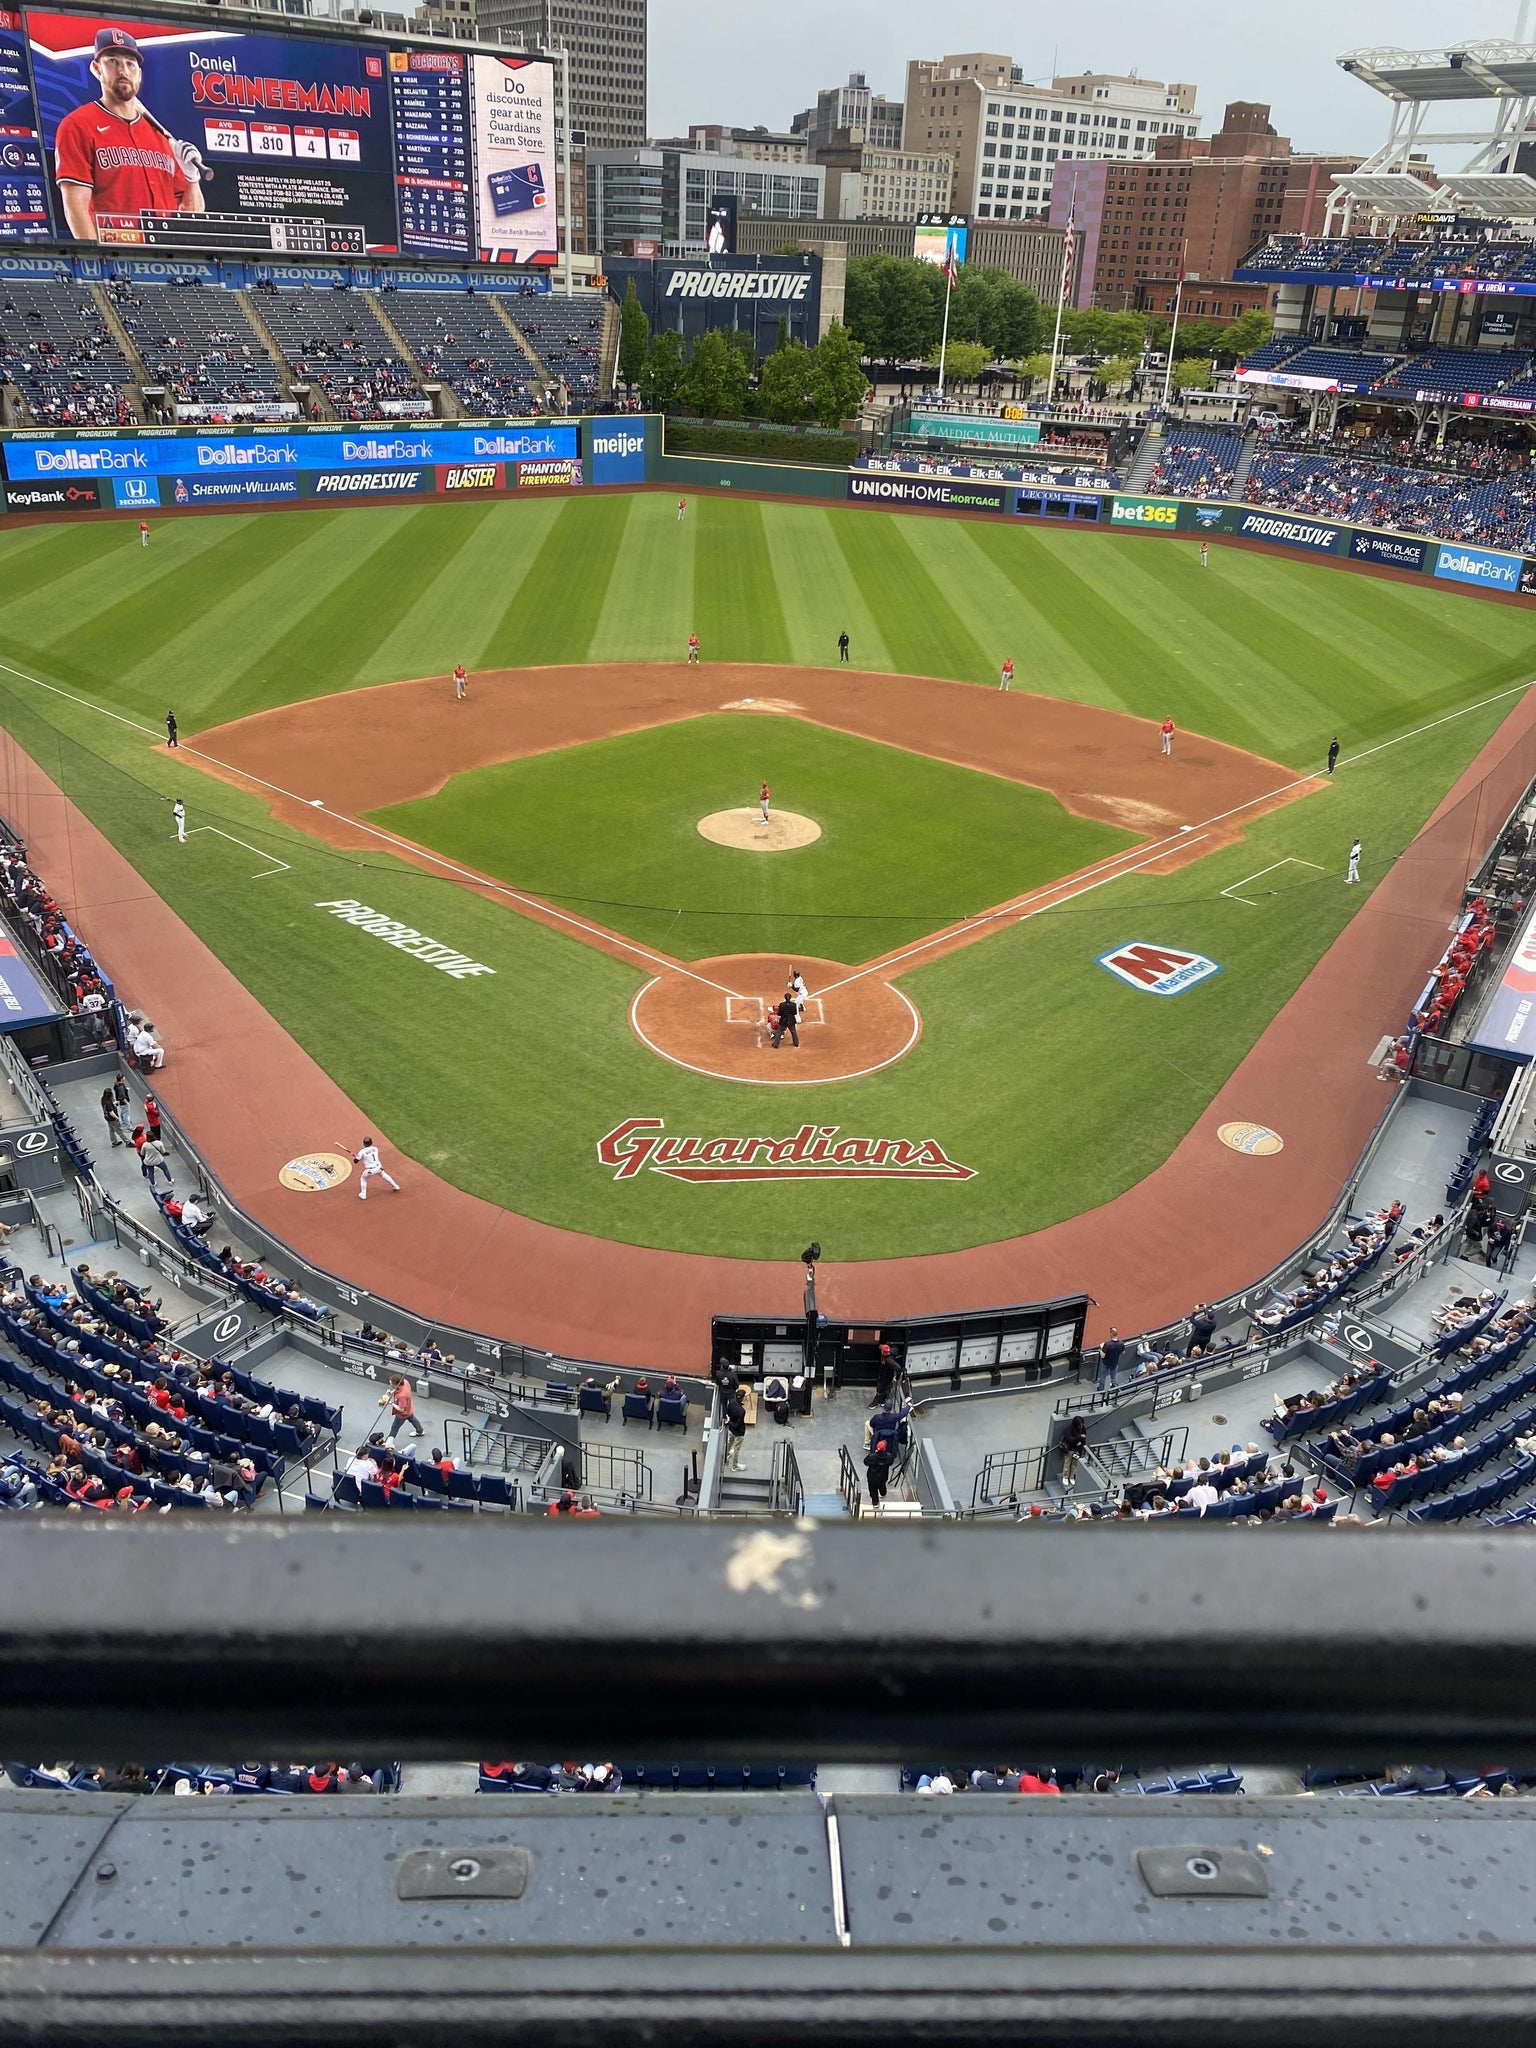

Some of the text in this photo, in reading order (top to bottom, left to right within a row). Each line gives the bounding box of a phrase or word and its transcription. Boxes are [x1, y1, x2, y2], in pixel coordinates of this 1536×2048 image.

[111, 29, 124, 45] C
[189, 51, 237, 72] Daniel
[409, 55, 459, 70] GUARDIANS
[504, 77, 525, 94] Do
[191, 71, 372, 118] SCHNEEMANN
[486, 92, 542, 107] discounted
[490, 108, 542, 121] gear at the
[489, 120, 541, 134] Guardians
[214, 133, 350, 156] .273 .810 4 17
[487, 133, 545, 148] Team Store.
[8, 151, 35, 161] 28 14
[3, 189, 41, 197] 24.0 3.00
[29, 205, 43, 213] 1.50
[120, 220, 135, 228] LAA
[147, 221, 154, 229] 0
[162, 221, 168, 230] 0
[289, 228, 294, 236] 3
[302, 228, 307, 236] 0
[330, 231, 336, 239] B
[347, 232, 353, 240] S
[354, 232, 361, 240] 2
[121, 232, 136, 241] CLE
[149, 234, 155, 242] 0
[0, 257, 71, 273] ONDA
[134, 259, 212, 277] HONDA
[273, 266, 344, 282] HONDA
[398, 272, 463, 286] HONDA
[481, 274, 544, 287] HONDA
[665, 270, 812, 300] PROGRESSIVE
[1463, 282, 1473, 291] 57
[1477, 283, 1485, 292] W.
[1266, 373, 1303, 386] DollarBank
[1467, 395, 1532, 410] 10 D. SCHNEEMANN
[1004, 407, 1023, 419] 0:08
[253, 426, 291, 434] PROGRESSIVE
[712, 419, 750, 429] PROGRESSIVE
[758, 423, 797, 433] PROGRESSIVE
[804, 427, 844, 436] PROGRESSIVE
[12, 431, 56, 439] PROGRESSIVE
[76, 430, 118, 438] PROGRESSIVE
[137, 429, 179, 437] PROGRESSIVE
[938, 427, 1031, 444] MEDICAL MUTUAL
[342, 439, 433, 461] DollarBank
[474, 435, 556, 455] DollarBank
[593, 432, 644, 454] meijer
[35, 449, 148, 471] DollarBank
[198, 444, 298, 466] DollarBank
[520, 462, 571, 475] PHANTOM
[316, 472, 422, 492] PROGRESSIVE
[446, 468, 496, 488] BLASTER
[520, 474, 570, 486] FIREWORKS
[7, 490, 65, 506] KeyBank
[119, 498, 157, 506] HONDA
[950, 494, 1000, 507] MORTGAGE
[1112, 502, 1178, 524] bet365
[1241, 515, 1338, 547] PROGRESSIVE
[1372, 540, 1421, 558] PARK PLACE
[1381, 551, 1419, 563] TECHNOLOGIES
[1439, 552, 1516, 582] DollarBank
[314, 898, 498, 979] PROGRESSIVE
[1108, 945, 1195, 986] M
[1152, 960, 1213, 992] Marathon
[89, 1000, 99, 1008] 37
[597, 1117, 980, 1183] Guardians
[350, 1292, 359, 1306] 5
[491, 1346, 502, 1359] 4
[365, 1364, 377, 1380] 4
[1262, 1359, 1270, 1373] 1
[1172, 1388, 1183, 1403] 2
[498, 1402, 510, 1419] 3
